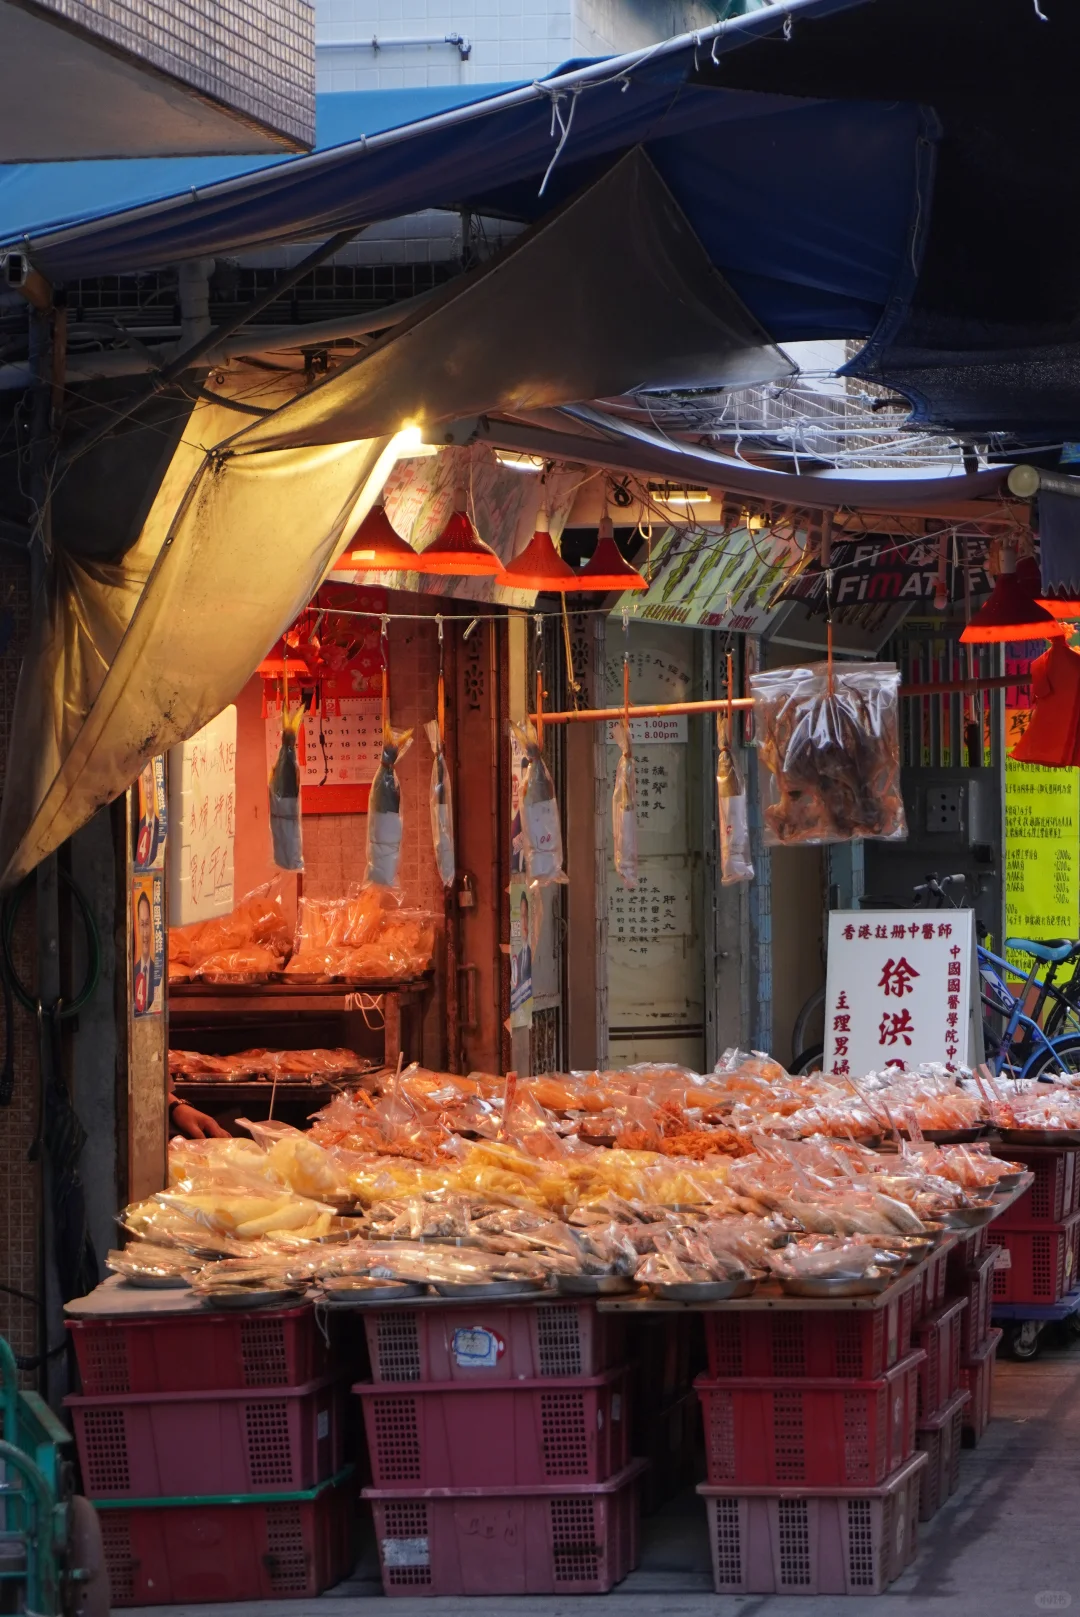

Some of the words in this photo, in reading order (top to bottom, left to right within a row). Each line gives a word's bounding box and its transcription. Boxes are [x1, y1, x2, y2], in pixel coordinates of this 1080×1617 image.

[644, 720, 678, 729] 1.00pm
[644, 731, 679, 740] 8.00pm
[138, 831, 147, 859] 4
[137, 978, 144, 1006] 4
